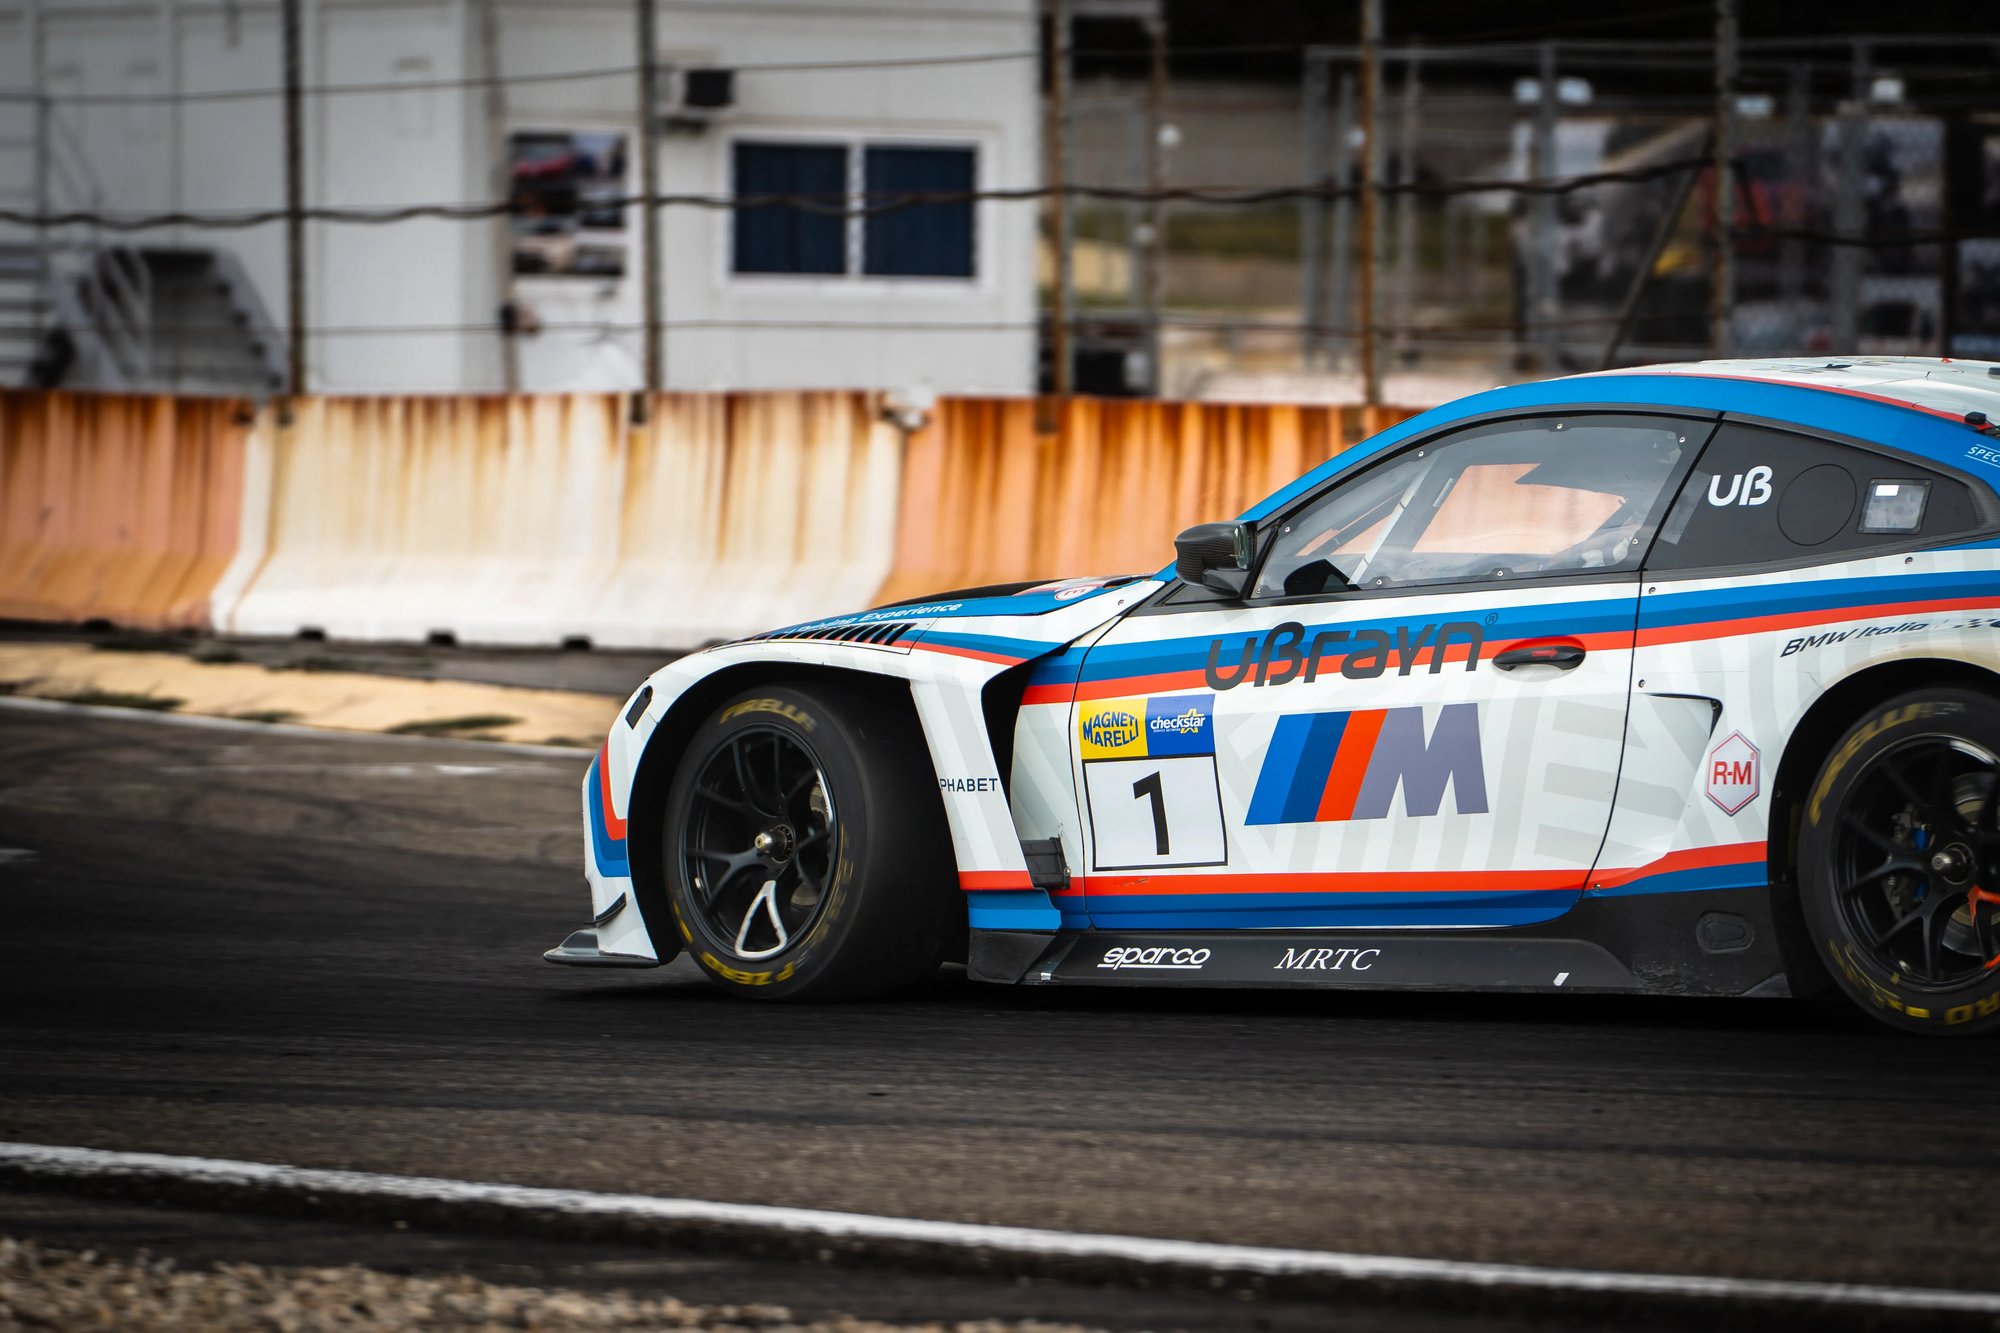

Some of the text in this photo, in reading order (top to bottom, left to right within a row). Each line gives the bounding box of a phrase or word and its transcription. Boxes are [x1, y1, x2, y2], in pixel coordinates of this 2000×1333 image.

[1967, 446, 2000, 464] SPEC
[859, 603, 963, 622] Experience
[1780, 621, 1931, 658] BMW Italia
[1083, 711, 1139, 735] MAGNETI
[1150, 714, 1206, 729] checkstar
[1083, 723, 1139, 748] MARELLI
[1132, 770, 1170, 856] 1
[1097, 947, 1211, 970] sparco
[1273, 947, 1381, 971] MRTC
